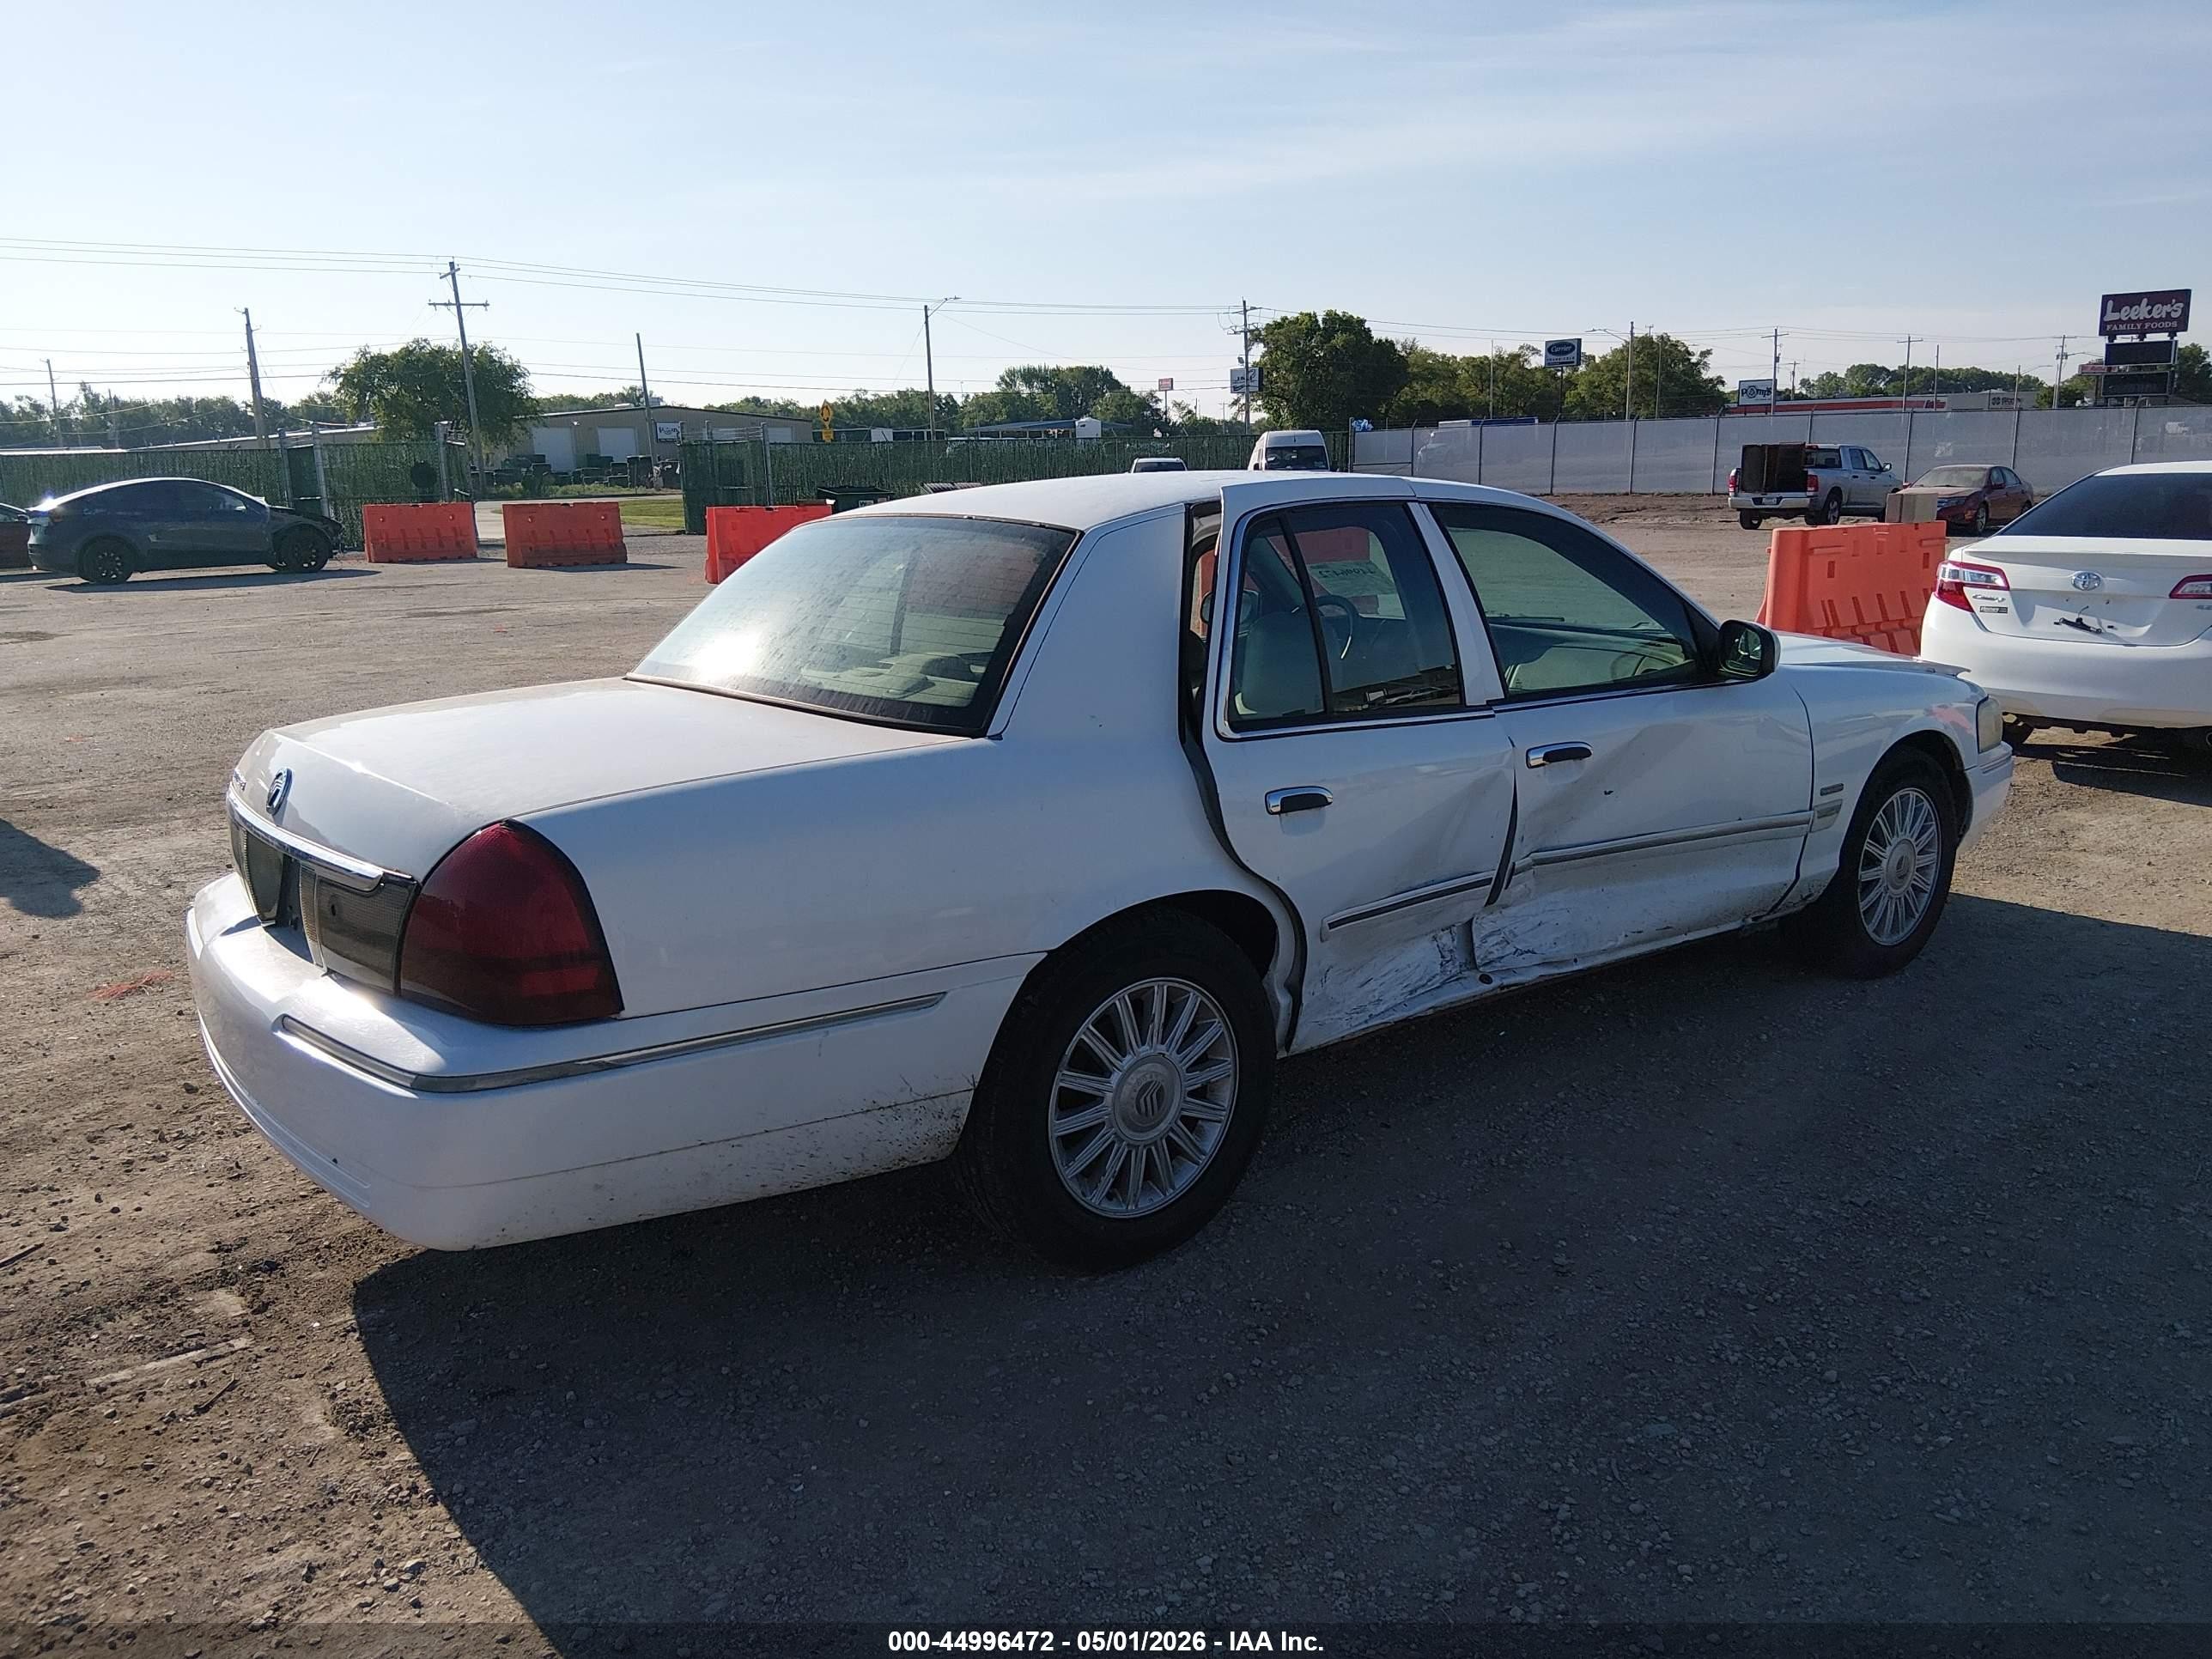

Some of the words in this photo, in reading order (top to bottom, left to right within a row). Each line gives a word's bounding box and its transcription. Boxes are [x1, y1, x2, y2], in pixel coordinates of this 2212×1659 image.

[2103, 298, 2185, 322] Leeker's
[2106, 322, 2143, 331] FAMILY
[2144, 320, 2179, 330] FOODS
[1551, 344, 1572, 353] Carrier
